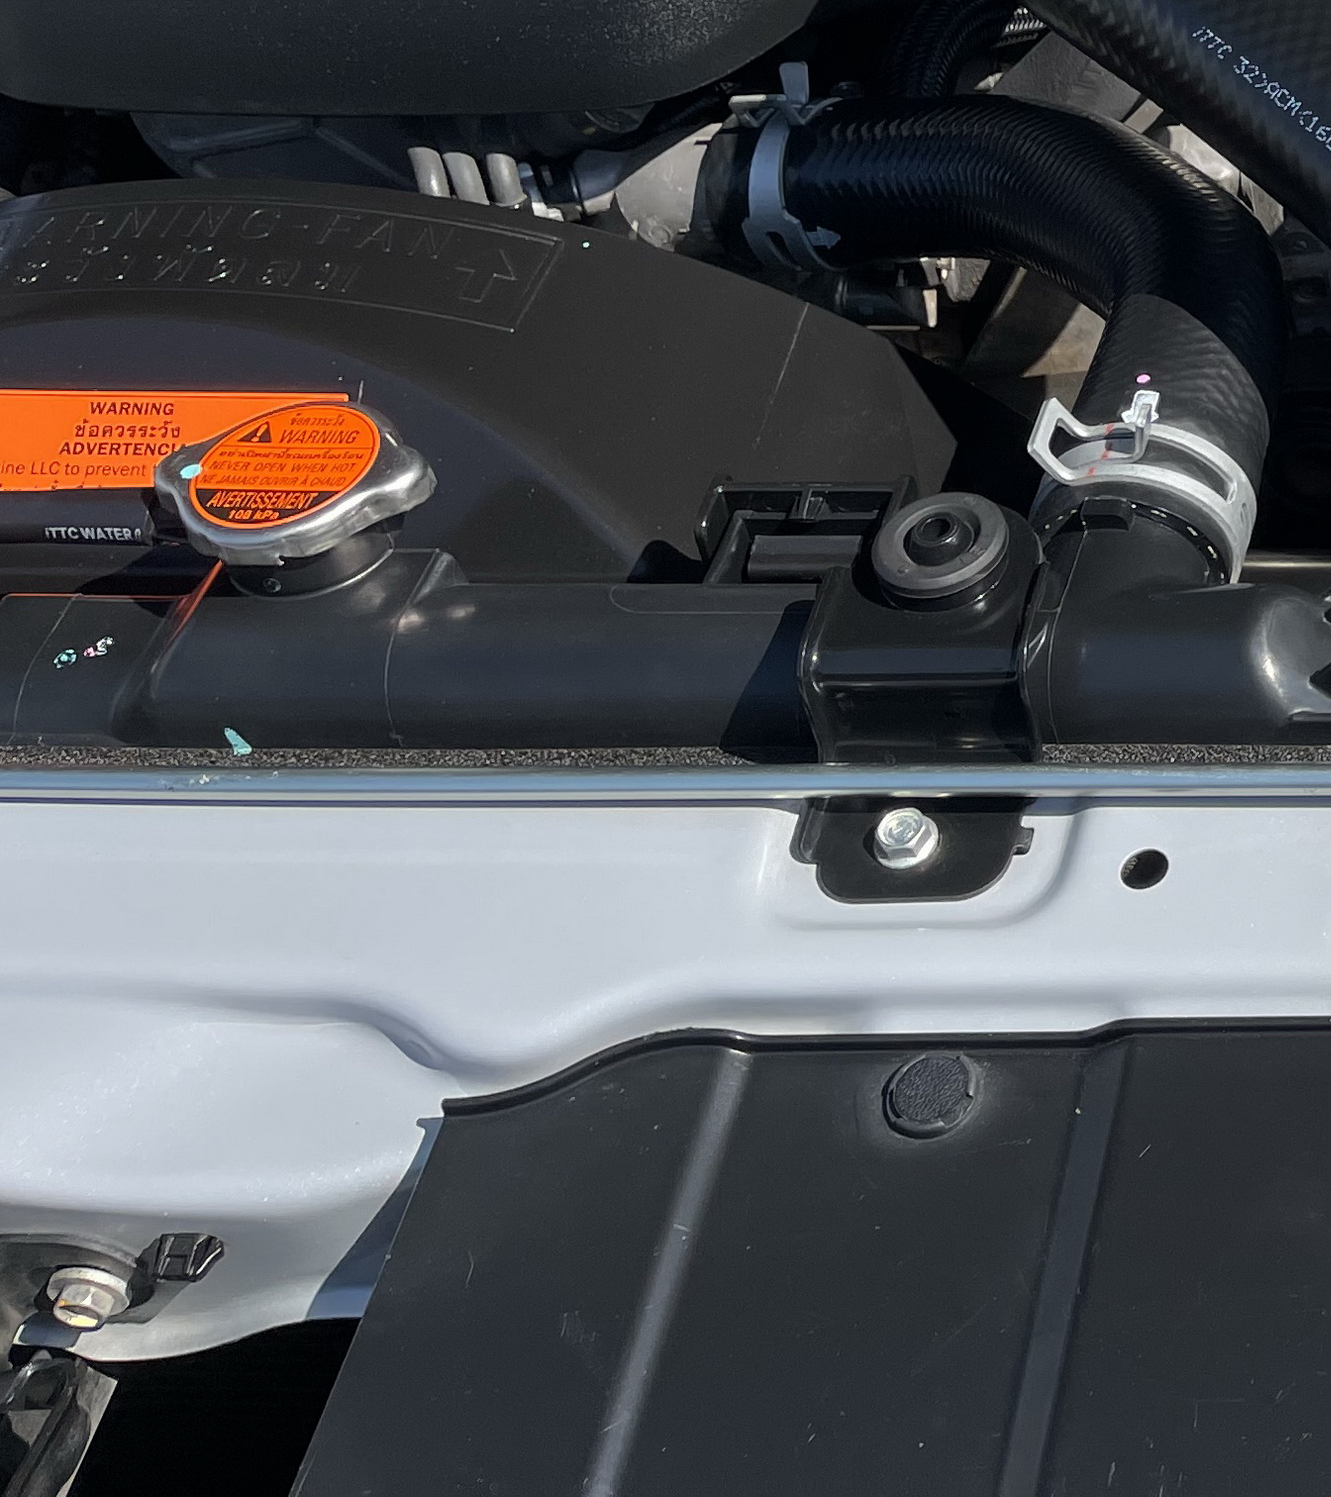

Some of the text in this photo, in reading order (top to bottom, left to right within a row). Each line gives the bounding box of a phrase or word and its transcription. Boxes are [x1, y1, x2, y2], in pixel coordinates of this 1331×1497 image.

[89, 401, 175, 416] WARNING
[74, 418, 181, 439] ข้อควรระวัง
[278, 429, 360, 445] WARNING
[58, 441, 187, 457] ADVERTENCI
[30, 462, 61, 476] LLC
[64, 463, 80, 476] to
[84, 463, 147, 482] prevent
[209, 460, 357, 473] NEVER OPEN WHEN HOT
[200, 474, 217, 484] NE
[218, 475, 259, 485] JAMAIS
[259, 476, 299, 486] OUVRIR
[311, 476, 346, 487] CHAUD
[205, 492, 318, 509] AVERTISSEMENT
[253, 509, 280, 520] kPa
[80, 527, 132, 542] WATER
